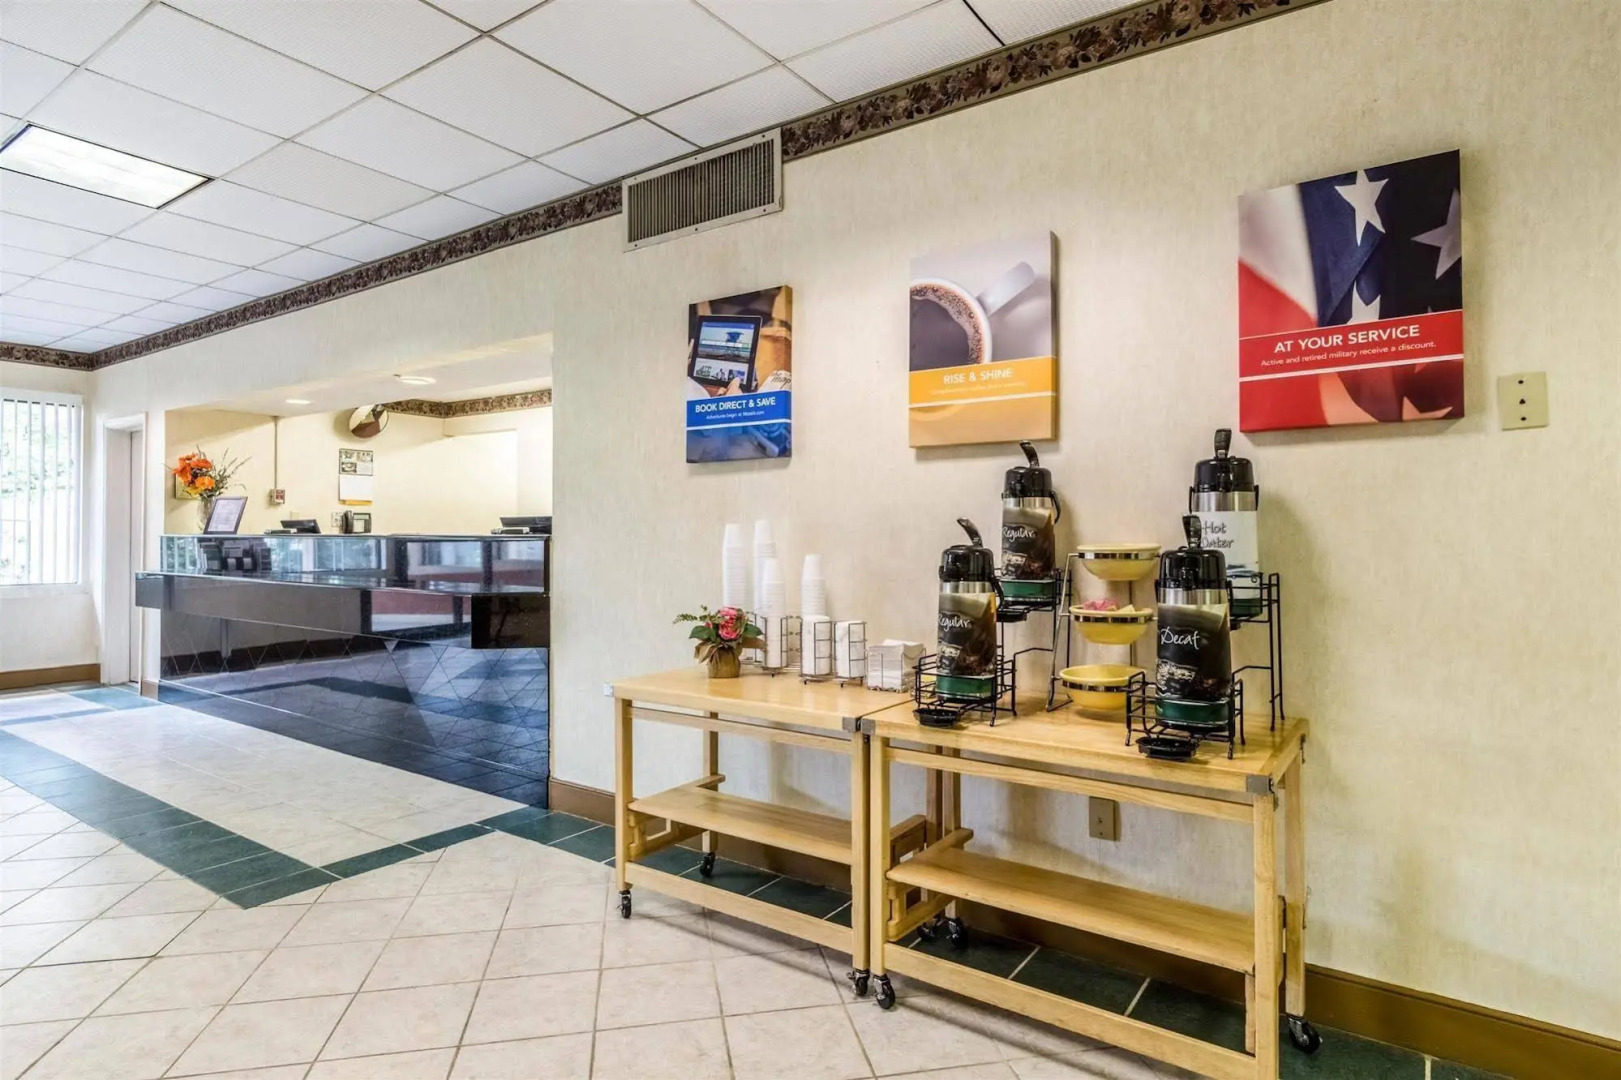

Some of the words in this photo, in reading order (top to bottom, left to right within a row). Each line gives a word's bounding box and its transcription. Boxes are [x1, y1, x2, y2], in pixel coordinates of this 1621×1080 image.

[1274, 341, 1294, 353] AT
[1298, 335, 1343, 350] YOUR
[1348, 324, 1420, 345] SERVICE
[1286, 356, 1300, 364] and
[1302, 353, 1327, 362] retired
[1329, 350, 1357, 358] military
[1360, 346, 1389, 355] receive
[1398, 341, 1436, 351] discount.
[944, 372, 965, 384] RISE
[969, 371, 977, 381] &
[980, 368, 1013, 380] SHINE
[695, 403, 717, 413] BOOK
[719, 400, 747, 410] DIRECT
[748, 399, 755, 408] &
[756, 397, 776, 407] SAVE
[1002, 527, 1034, 542] Regular
[1202, 521, 1227, 535] Hot
[1161, 626, 1200, 650] Decaf
